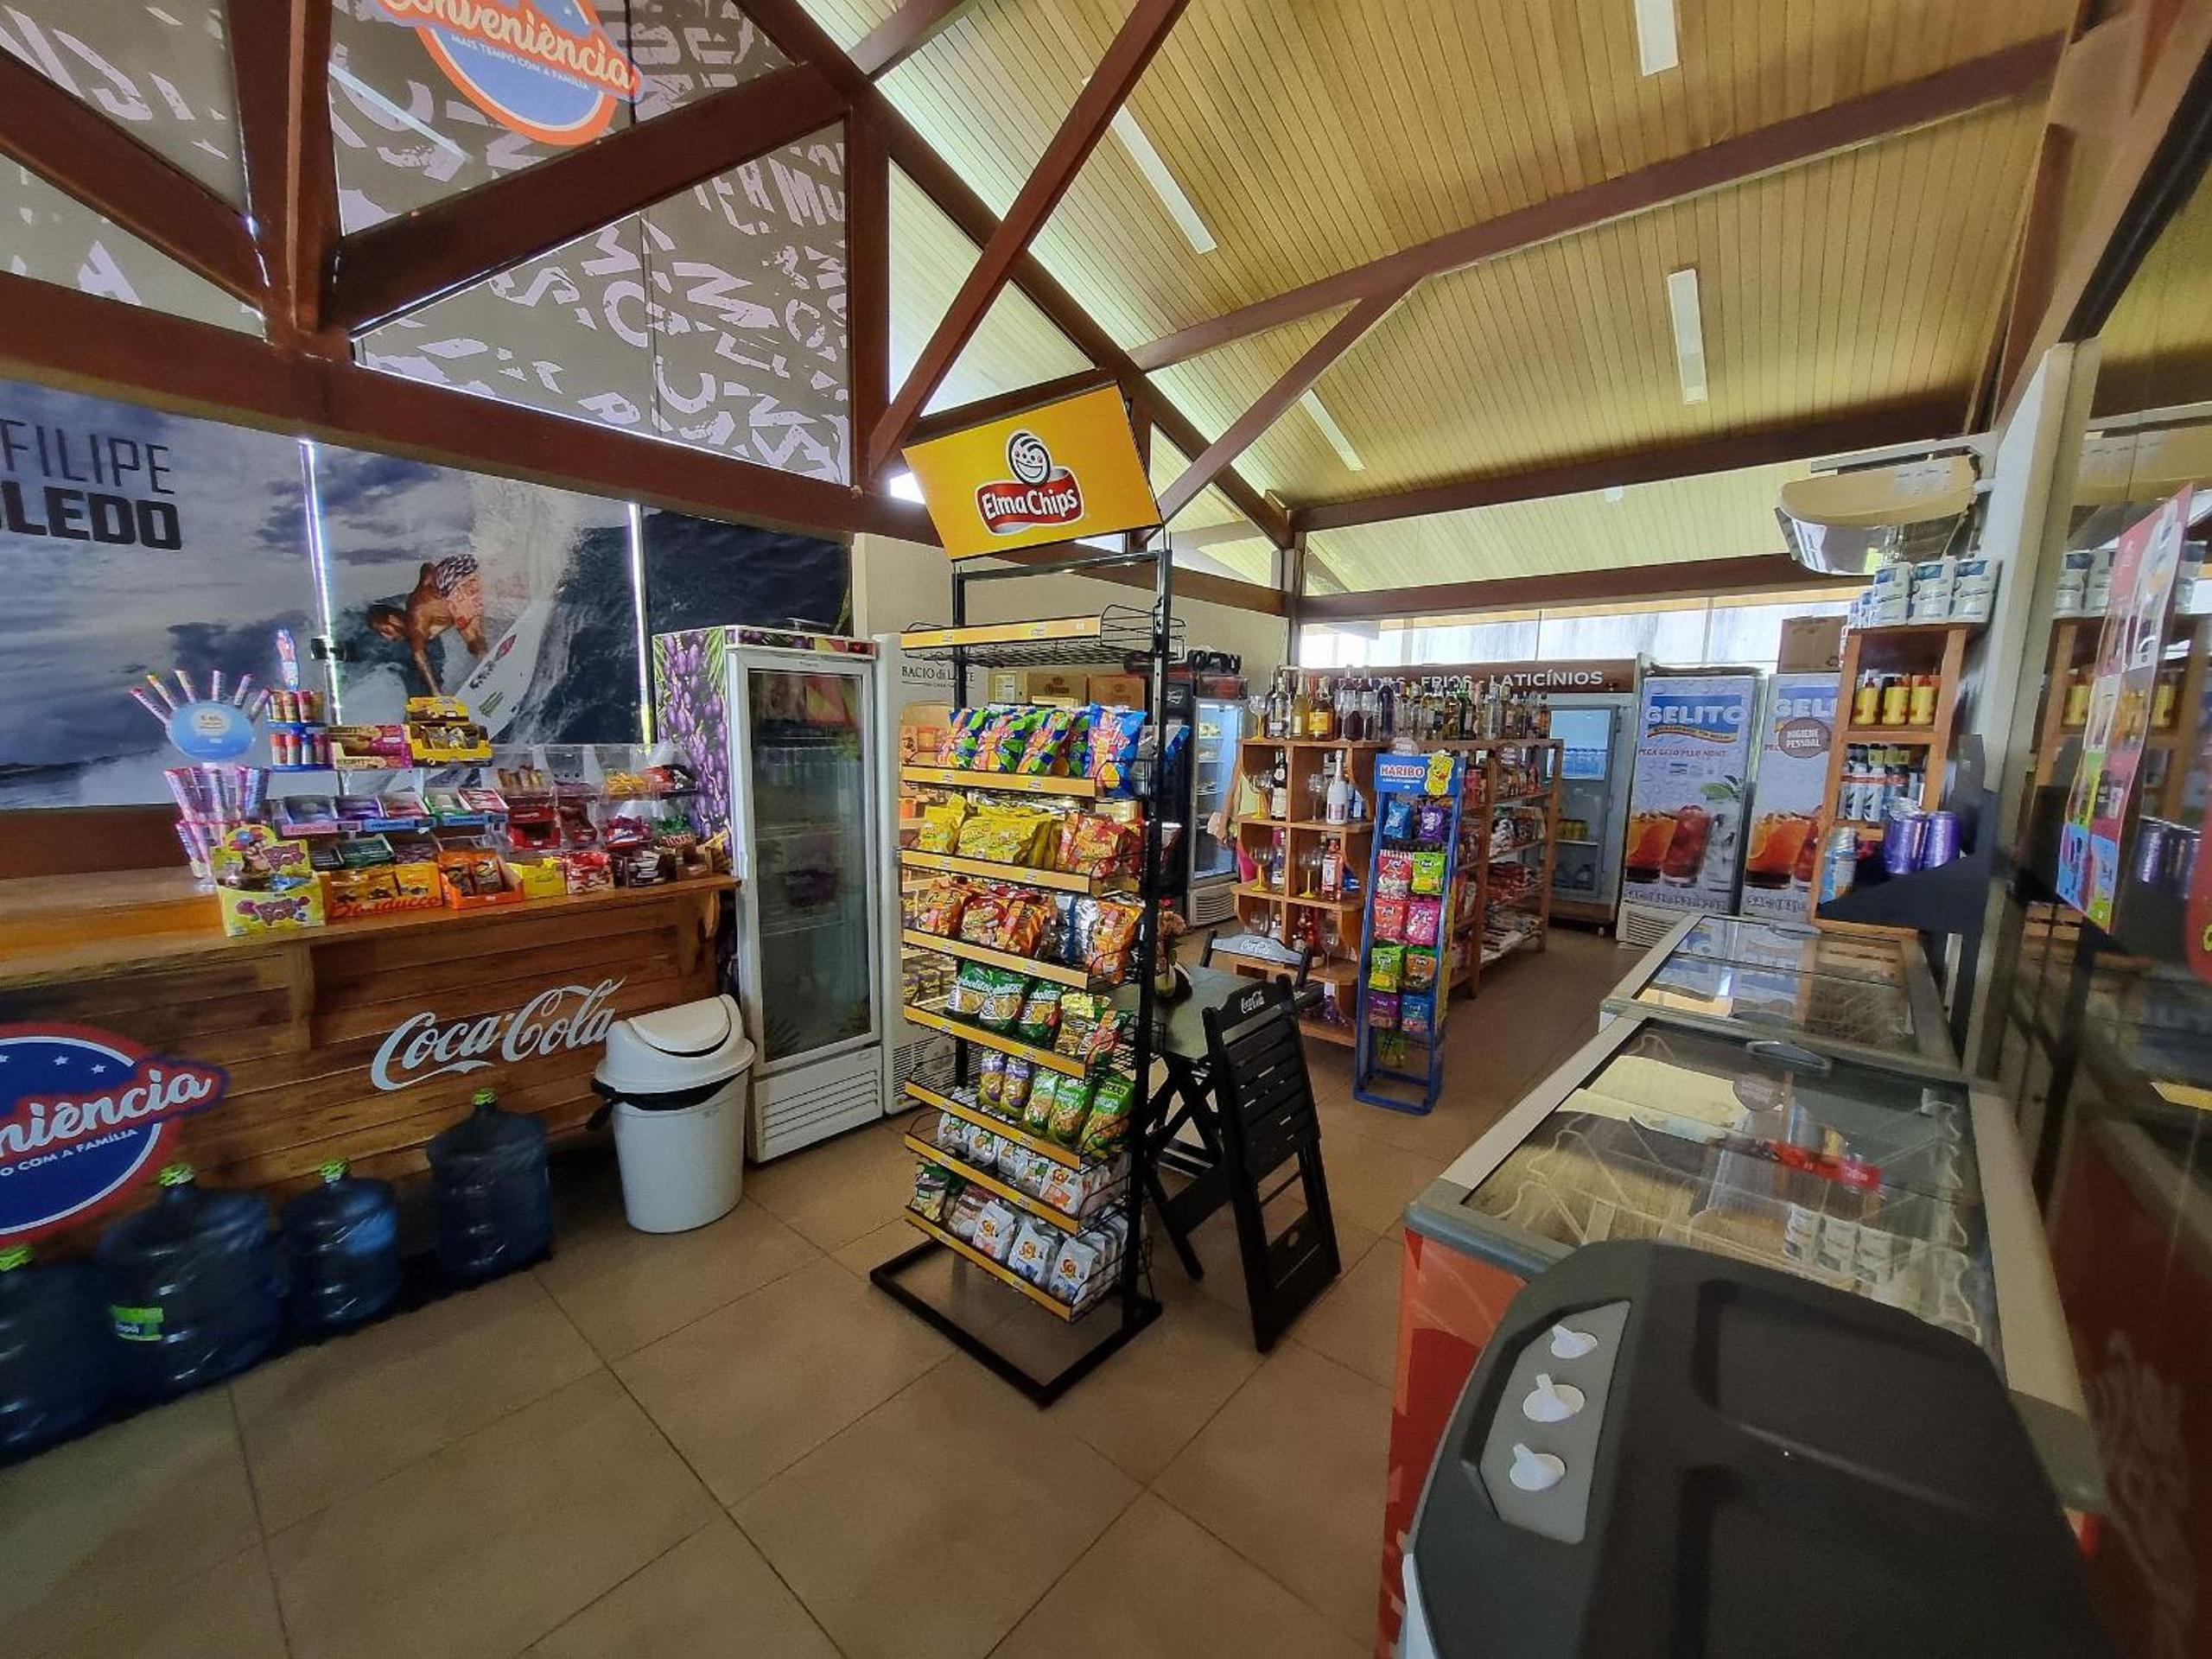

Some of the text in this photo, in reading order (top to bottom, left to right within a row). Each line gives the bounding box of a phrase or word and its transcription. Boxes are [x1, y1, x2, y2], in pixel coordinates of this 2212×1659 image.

[380, 0, 636, 90] nveniência
[451, 34, 479, 49] MAIS
[480, 43, 516, 64] TEMPO
[518, 58, 541, 73] COM
[543, 67, 551, 76] A
[0, 418, 175, 495] FILIPE
[0, 480, 181, 550] LEDO
[982, 488, 1078, 520] Elma Chips
[901, 666, 935, 679] BACIO
[1491, 669, 1605, 689] LATICÍNIOS
[1644, 705, 1749, 725] GELITO
[1785, 737, 1821, 748] PESSOAL
[1786, 728, 1820, 738] HIGIENE
[1380, 765, 1426, 778] HARIBO
[371, 976, 627, 1090] Coca-Cola
[17, 1153, 58, 1170] COM
[61, 1149, 74, 1159] A
[76, 1128, 138, 1153] FAMÍLIA
